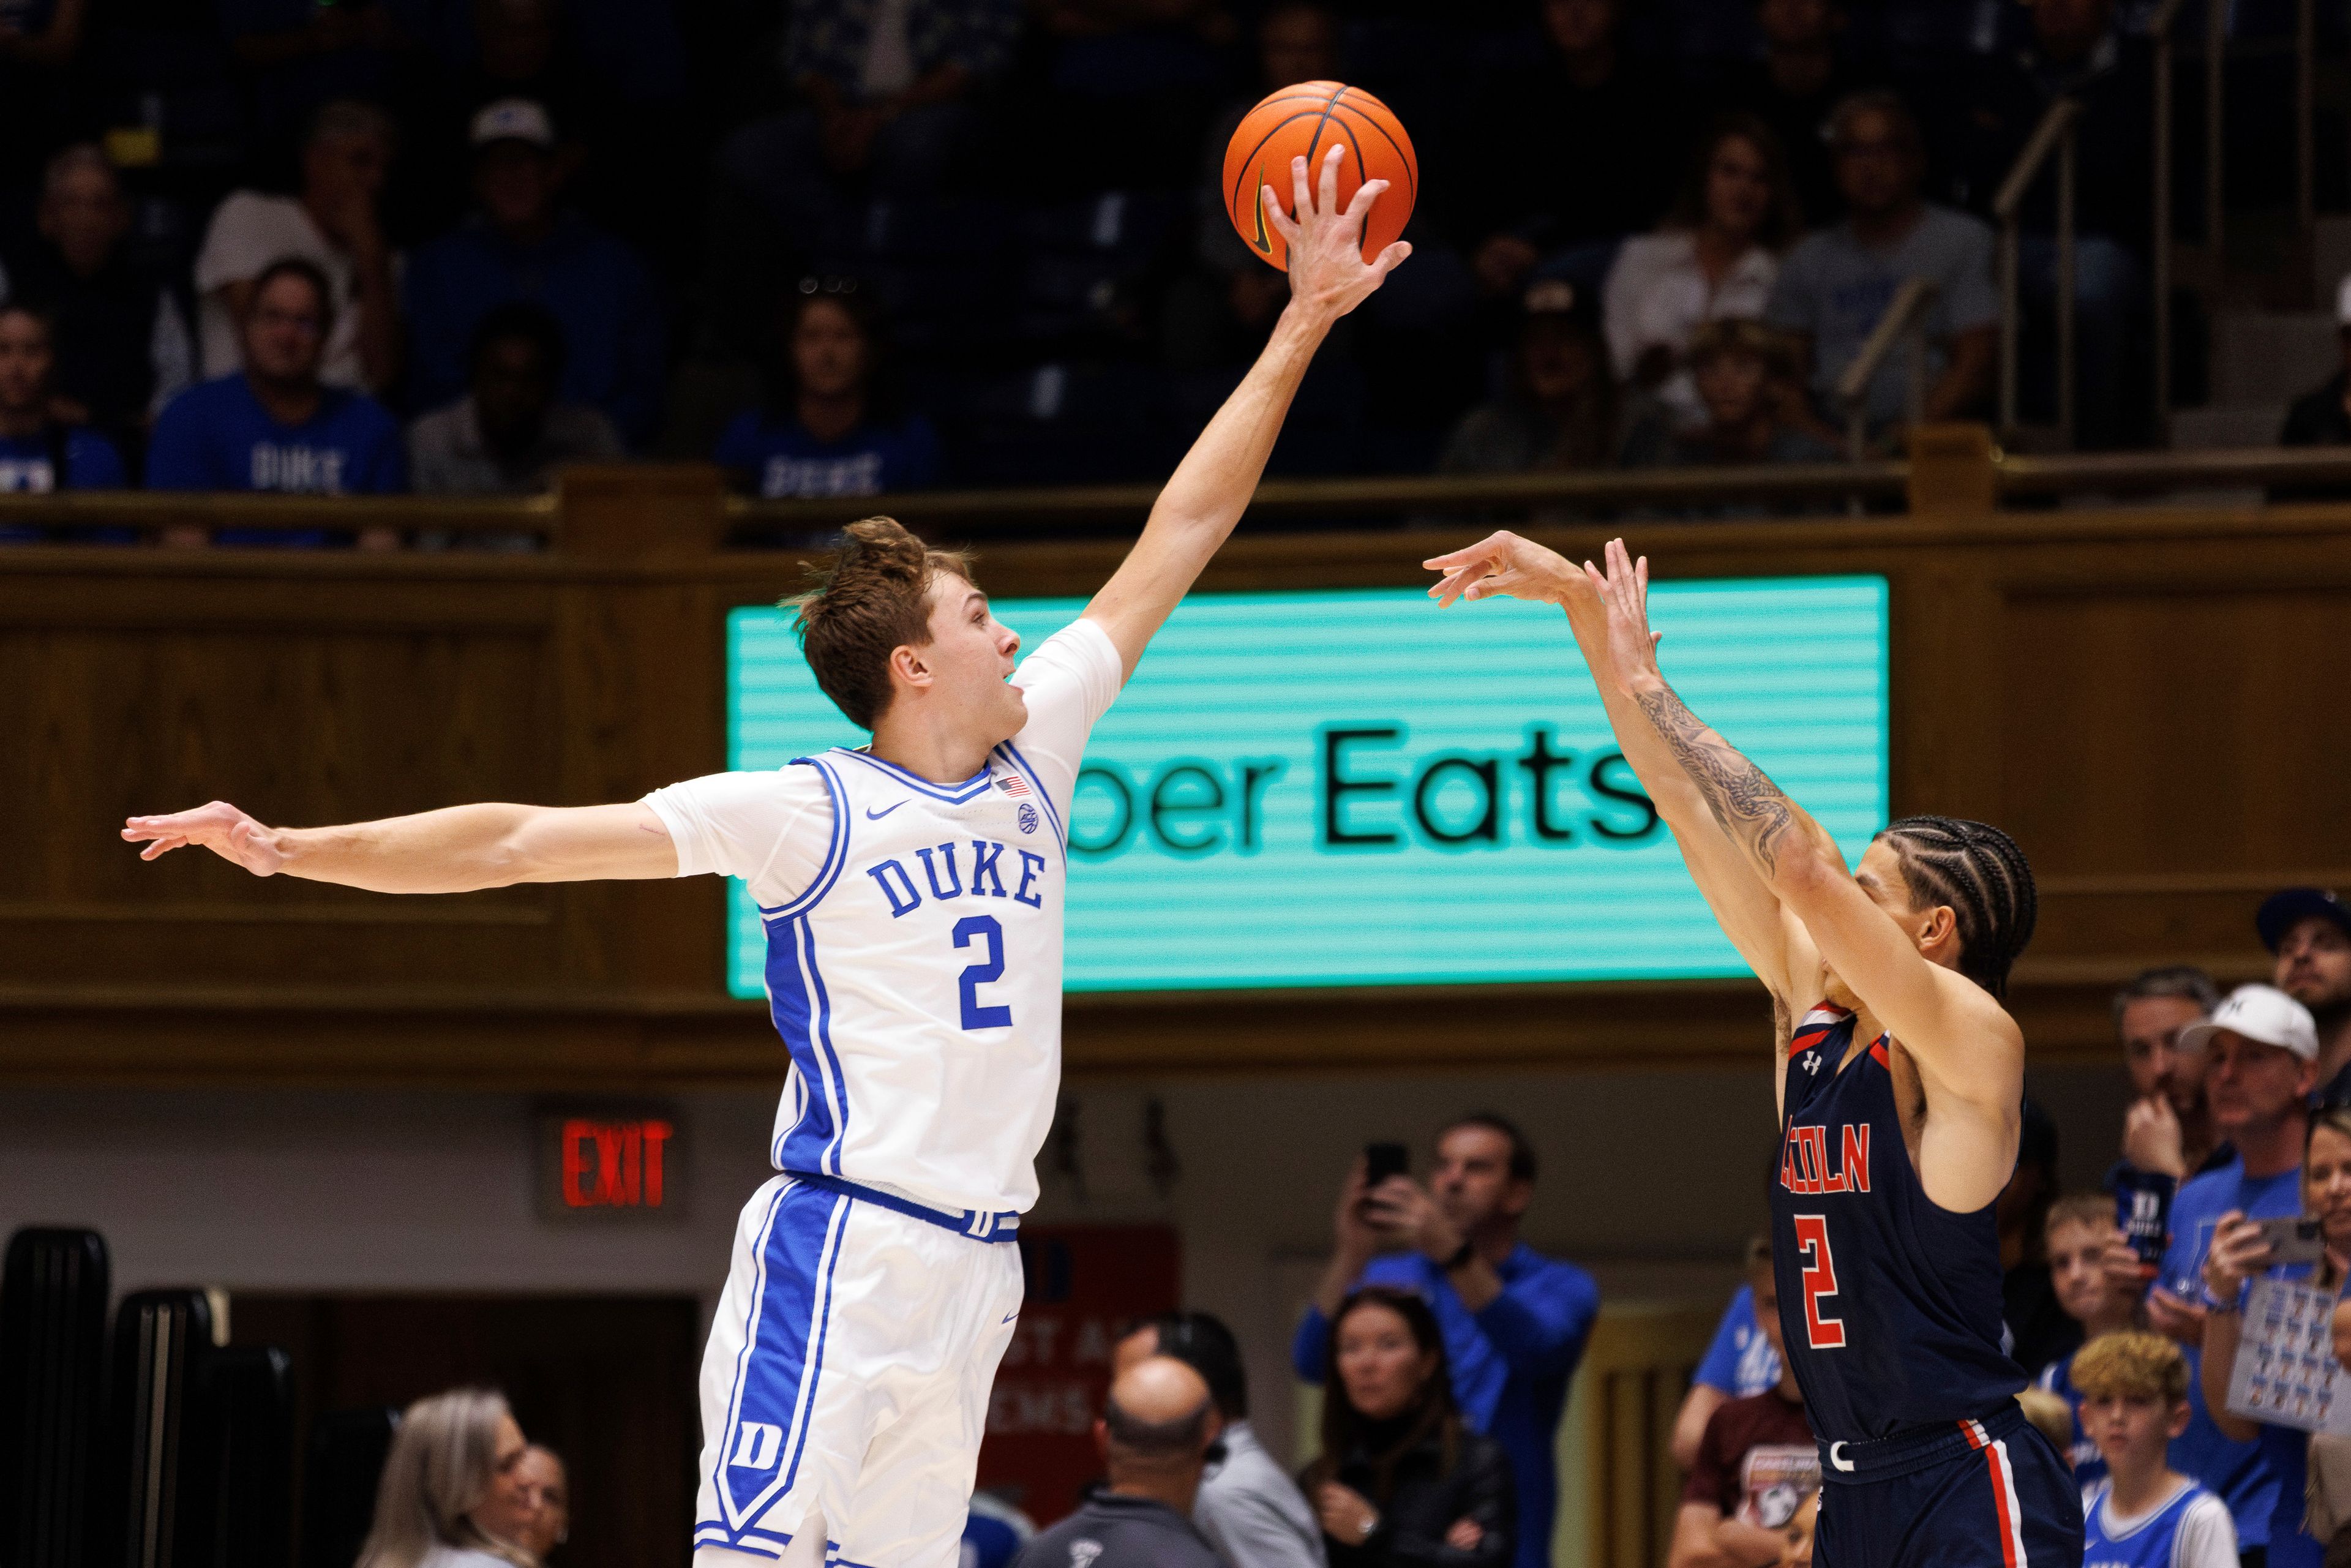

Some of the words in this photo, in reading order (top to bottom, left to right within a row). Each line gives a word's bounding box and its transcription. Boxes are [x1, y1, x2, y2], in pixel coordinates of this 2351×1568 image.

[1324, 729, 1657, 845] Eats
[866, 839, 1045, 918] DUKE
[951, 914, 1013, 1030] 2
[561, 1117, 673, 1208] EXIT
[1793, 1214, 1847, 1349] 2
[729, 1420, 784, 1471] D
